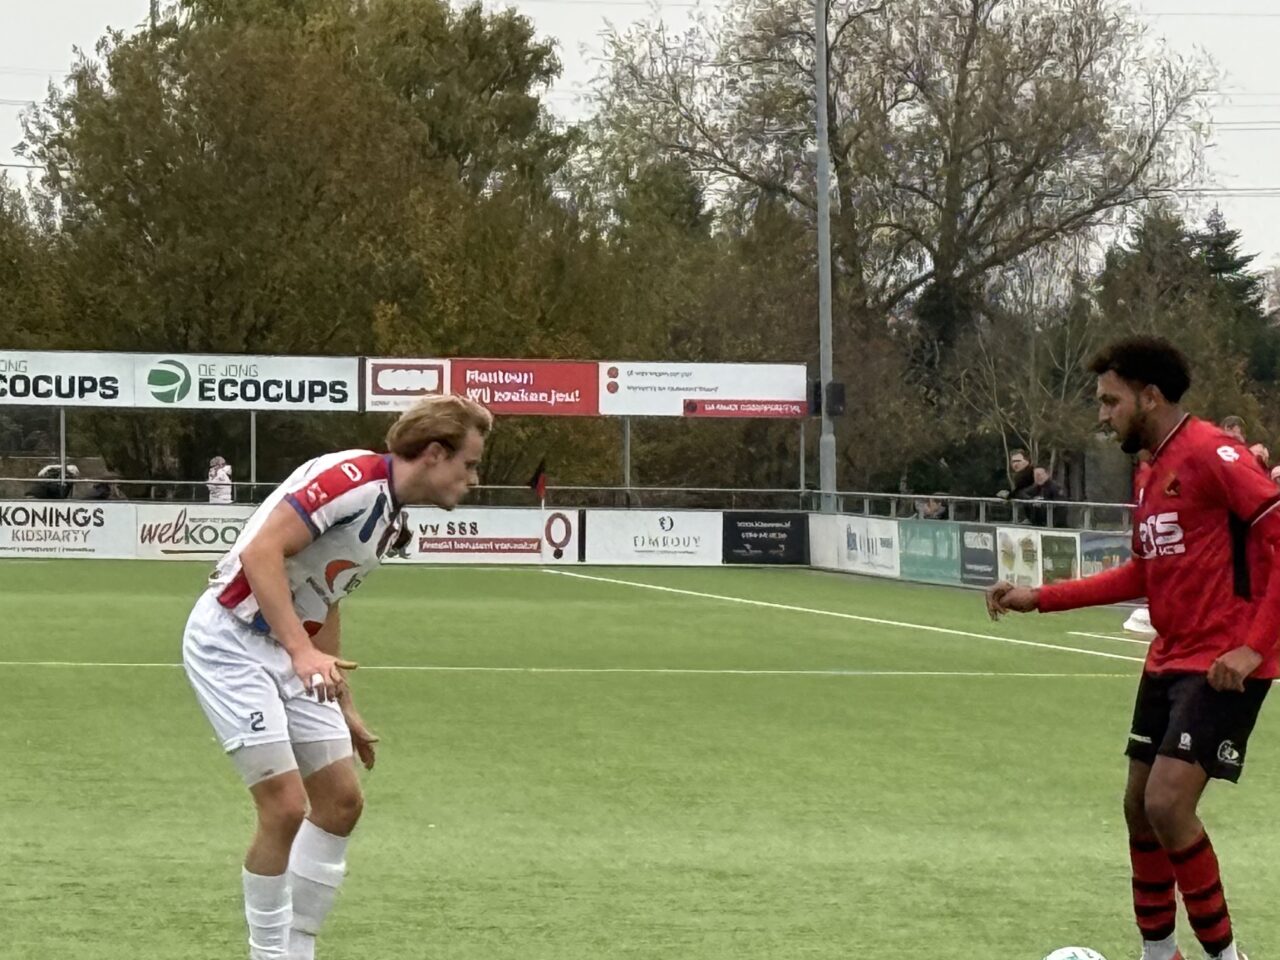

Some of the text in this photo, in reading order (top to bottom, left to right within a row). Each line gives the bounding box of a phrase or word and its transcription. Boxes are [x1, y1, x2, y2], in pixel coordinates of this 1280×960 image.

[198, 363, 259, 377] DE JONG
[198, 377, 349, 404] ECOCUPS
[0, 505, 105, 528] KONINGS
[11, 528, 91, 543] KIDSPARTY
[250, 711, 266, 731] 2
